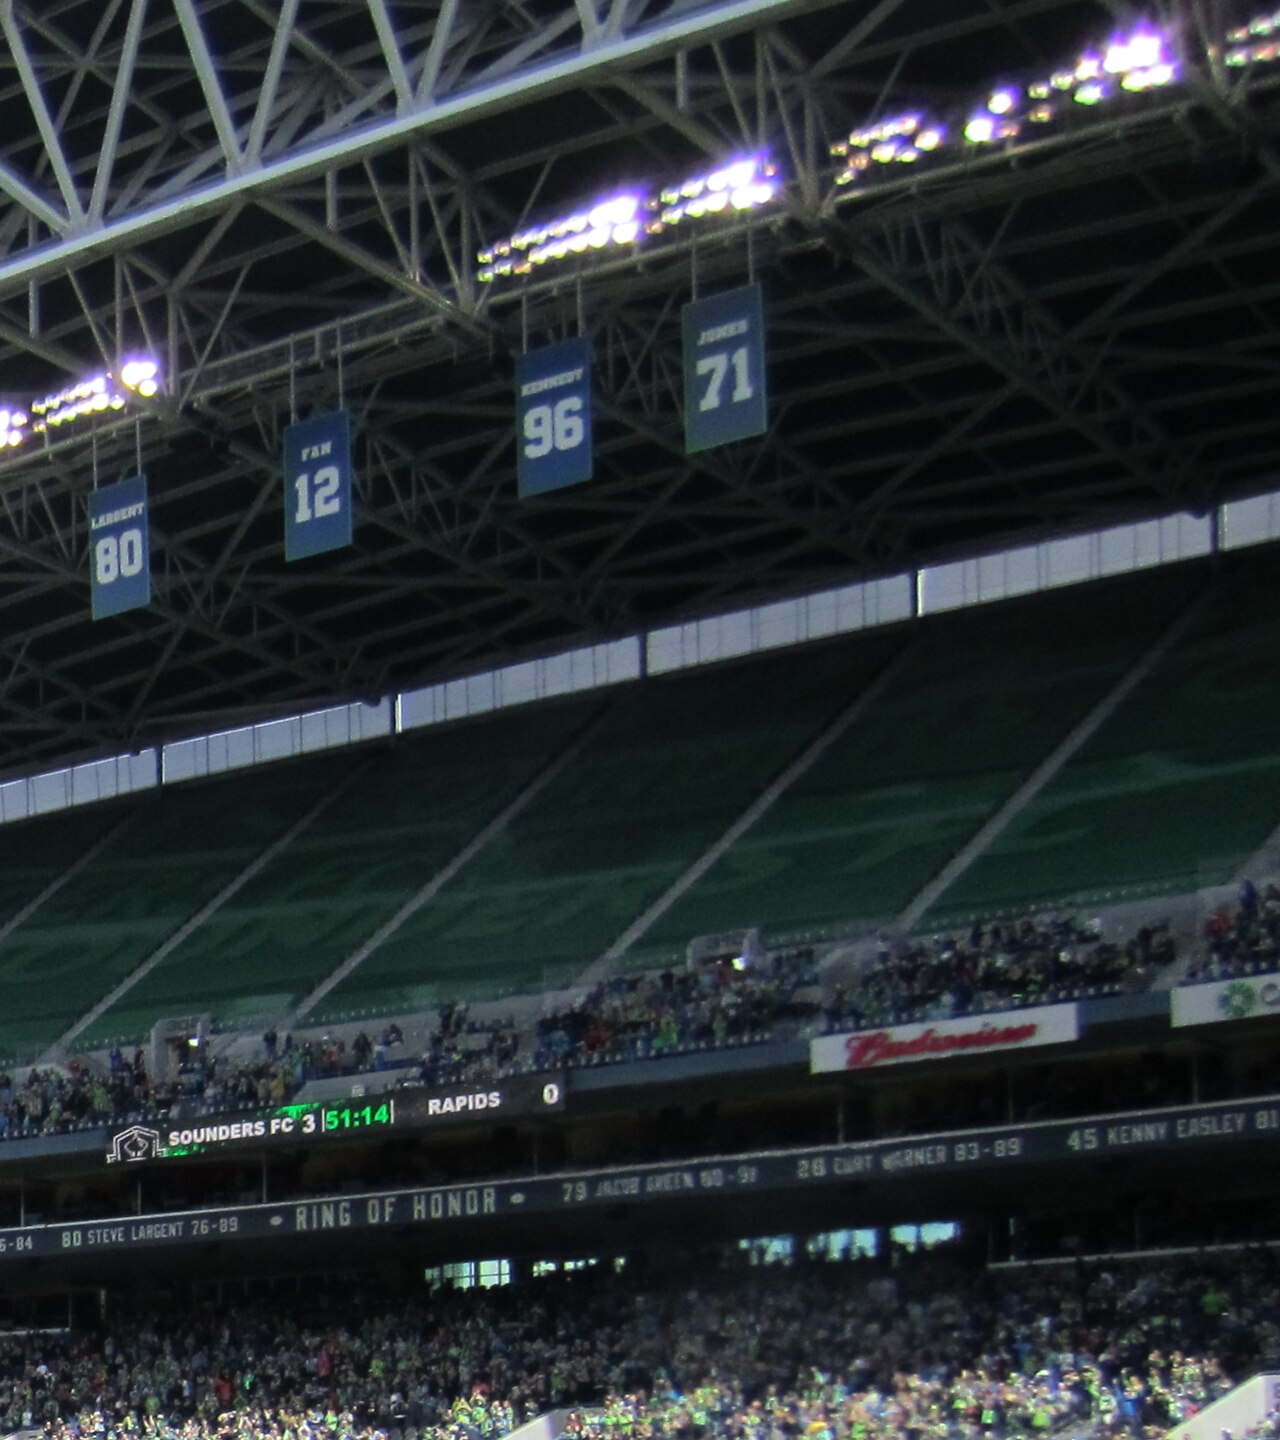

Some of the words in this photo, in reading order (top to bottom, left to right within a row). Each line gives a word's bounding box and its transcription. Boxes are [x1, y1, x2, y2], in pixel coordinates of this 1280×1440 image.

[696, 346, 754, 412] 71
[523, 396, 585, 460] 96
[300, 440, 334, 462] FAN
[90, 502, 145, 530] LARGENT
[294, 465, 341, 524] 12
[95, 528, 144, 585] 80
[168, 1121, 266, 1147] SOUNDERS
[270, 1119, 294, 1135] FC
[301, 1114, 316, 1134] 3
[325, 1103, 389, 1131] 51:14
[427, 1091, 501, 1116] RAPIDS
[542, 1083, 559, 1105] 0
[1066, 1128, 1099, 1151] 45
[1107, 1122, 1168, 1146] KENNY
[1176, 1112, 1246, 1138] EASLEY
[295, 1201, 352, 1231] RING
[367, 1197, 396, 1224] OF
[413, 1187, 496, 1220] HONOR
[562, 1181, 588, 1202] 79
[61, 1231, 82, 1248] 80
[87, 1227, 125, 1244] STEVE
[131, 1221, 184, 1240] LARGENT
[191, 1217, 238, 1236] 76-89
